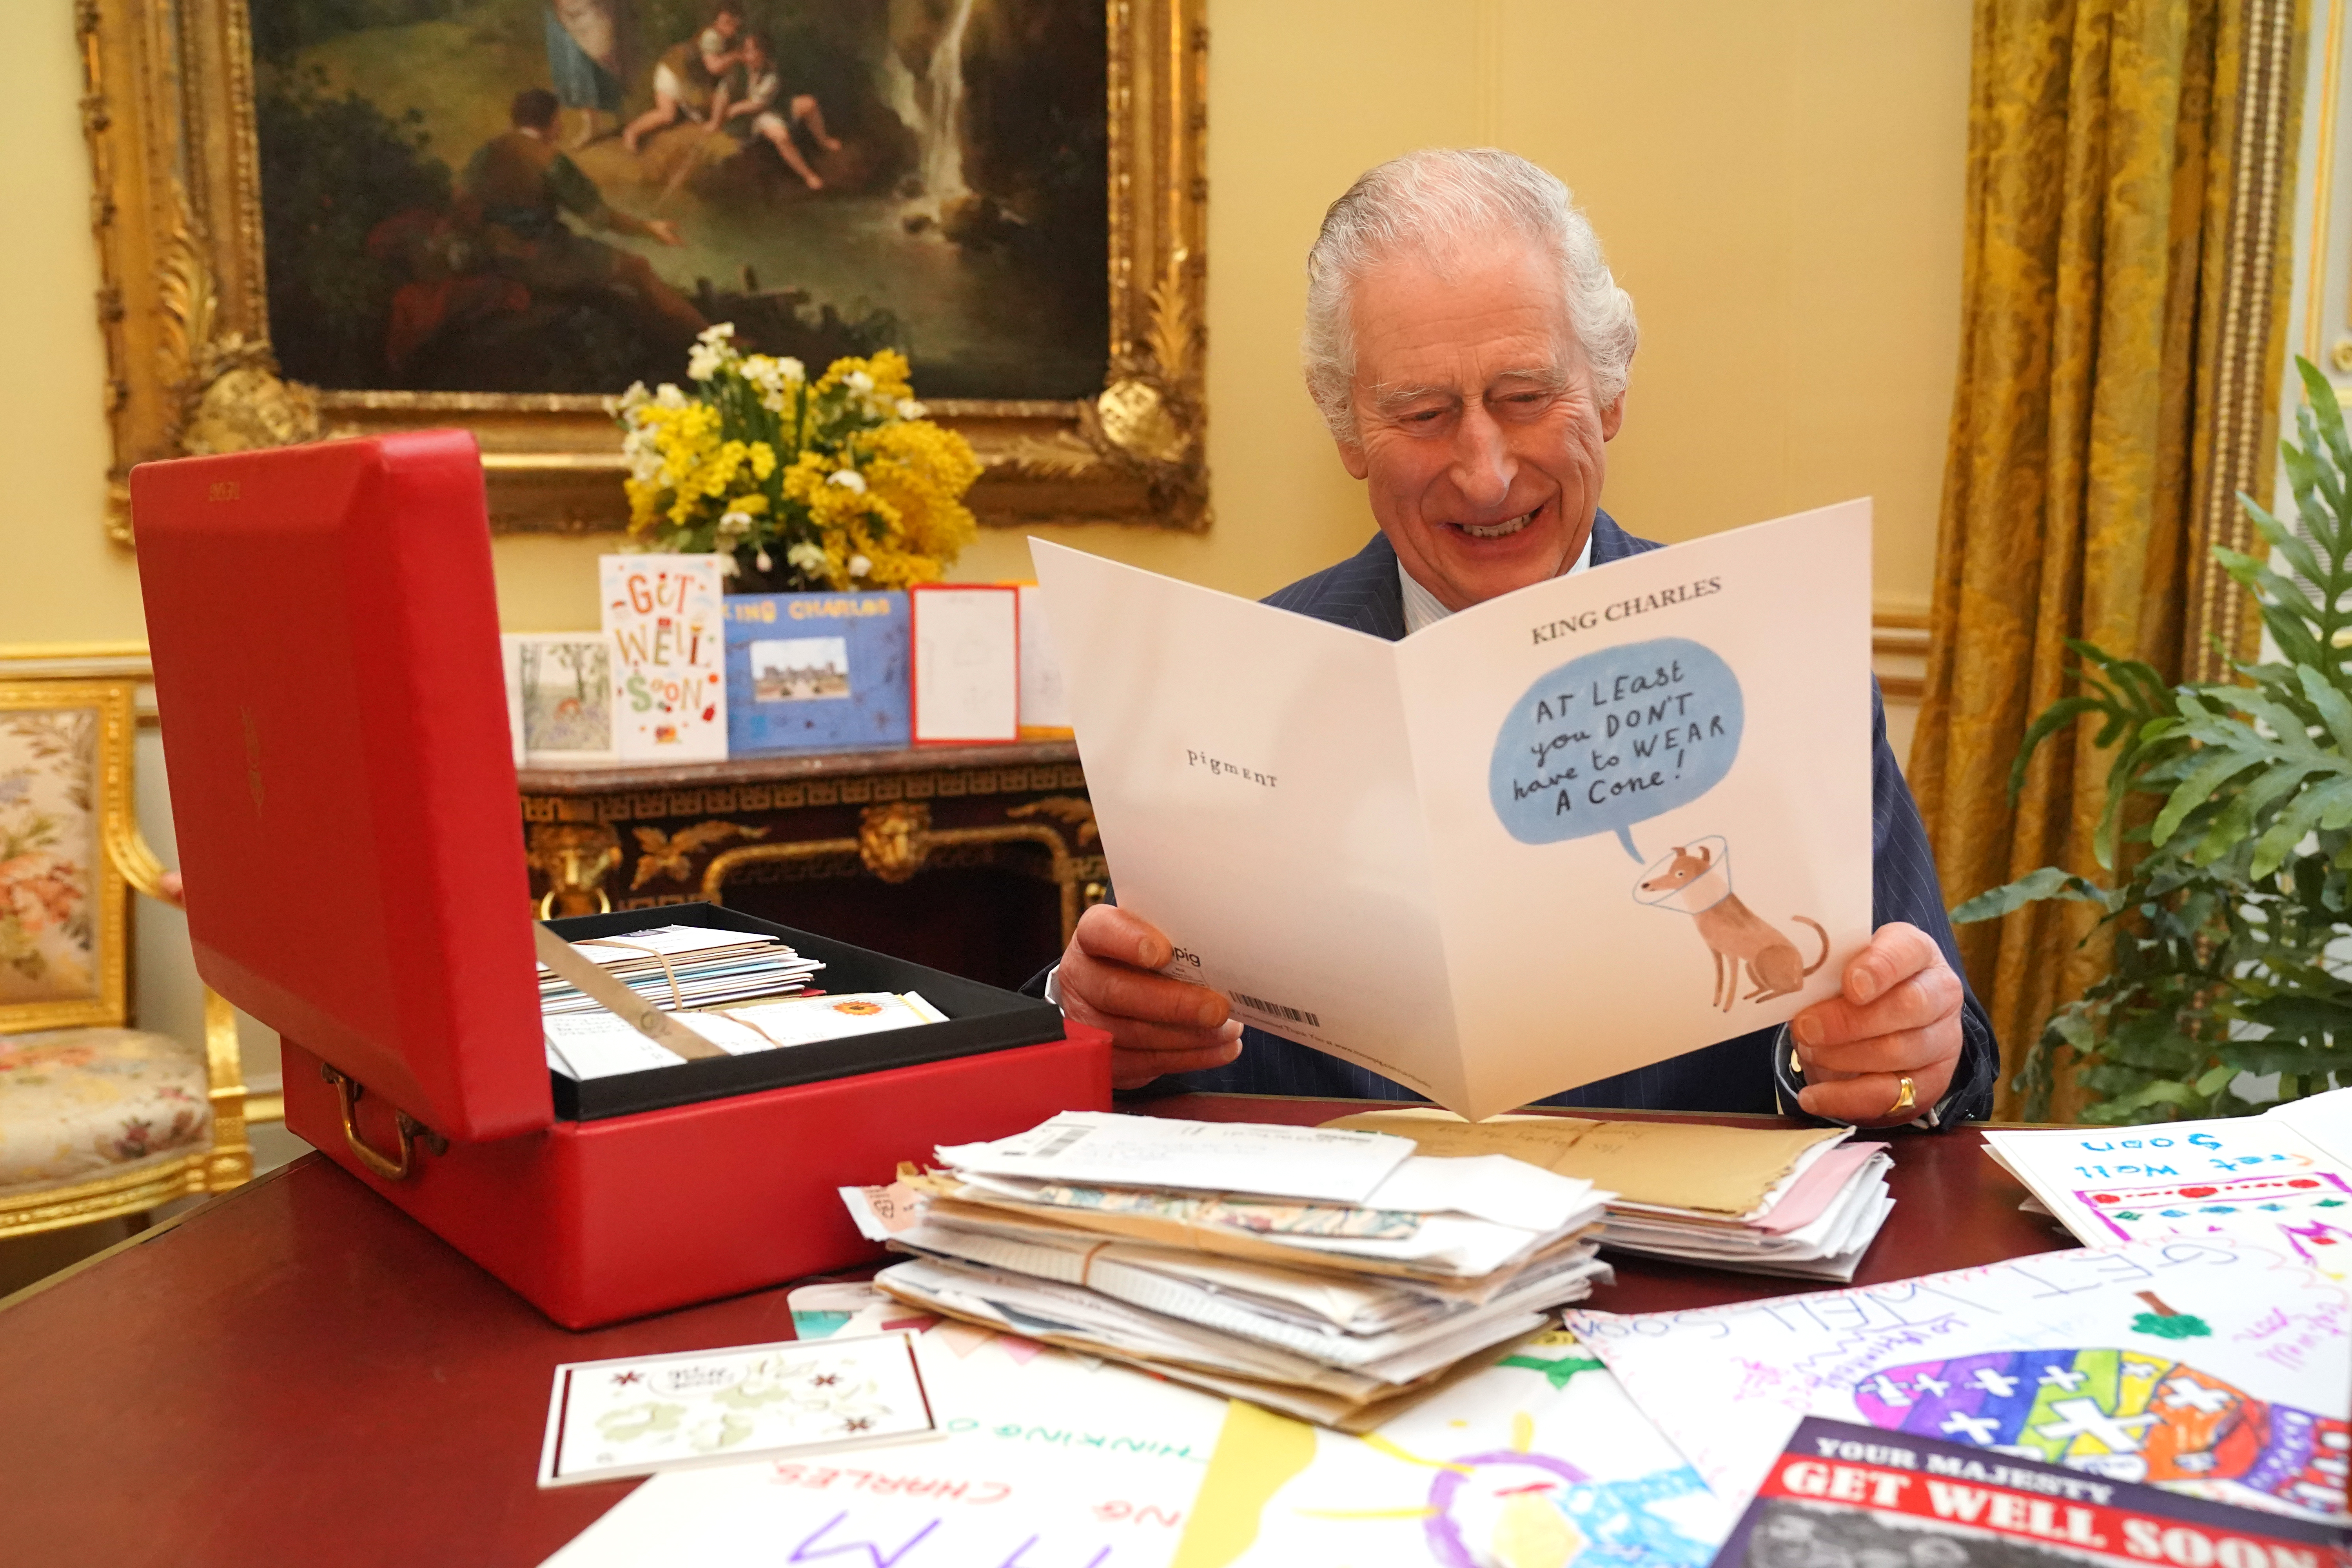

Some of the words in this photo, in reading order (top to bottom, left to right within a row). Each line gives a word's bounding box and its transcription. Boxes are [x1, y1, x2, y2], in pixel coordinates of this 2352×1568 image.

[1531, 611, 1598, 645] KING
[1604, 576, 1722, 621] CHARLES
[1536, 695, 1574, 723] AT
[1513, 768, 1578, 800] have
[1591, 749, 1619, 771] to
[1633, 714, 1724, 757] WEAR
[1555, 789, 1571, 816] A
[2080, 1133, 2224, 1152] Soon
[2074, 1164, 2181, 1178] Well
[2010, 1243, 2239, 1299] GET
[1815, 1436, 1918, 1471] YOUR
[1925, 1453, 2115, 1505] MAJESTY
[1781, 1459, 1912, 1509] GET
[1925, 1479, 2109, 1548] WELL
[2121, 1518, 2318, 1568] SOON
